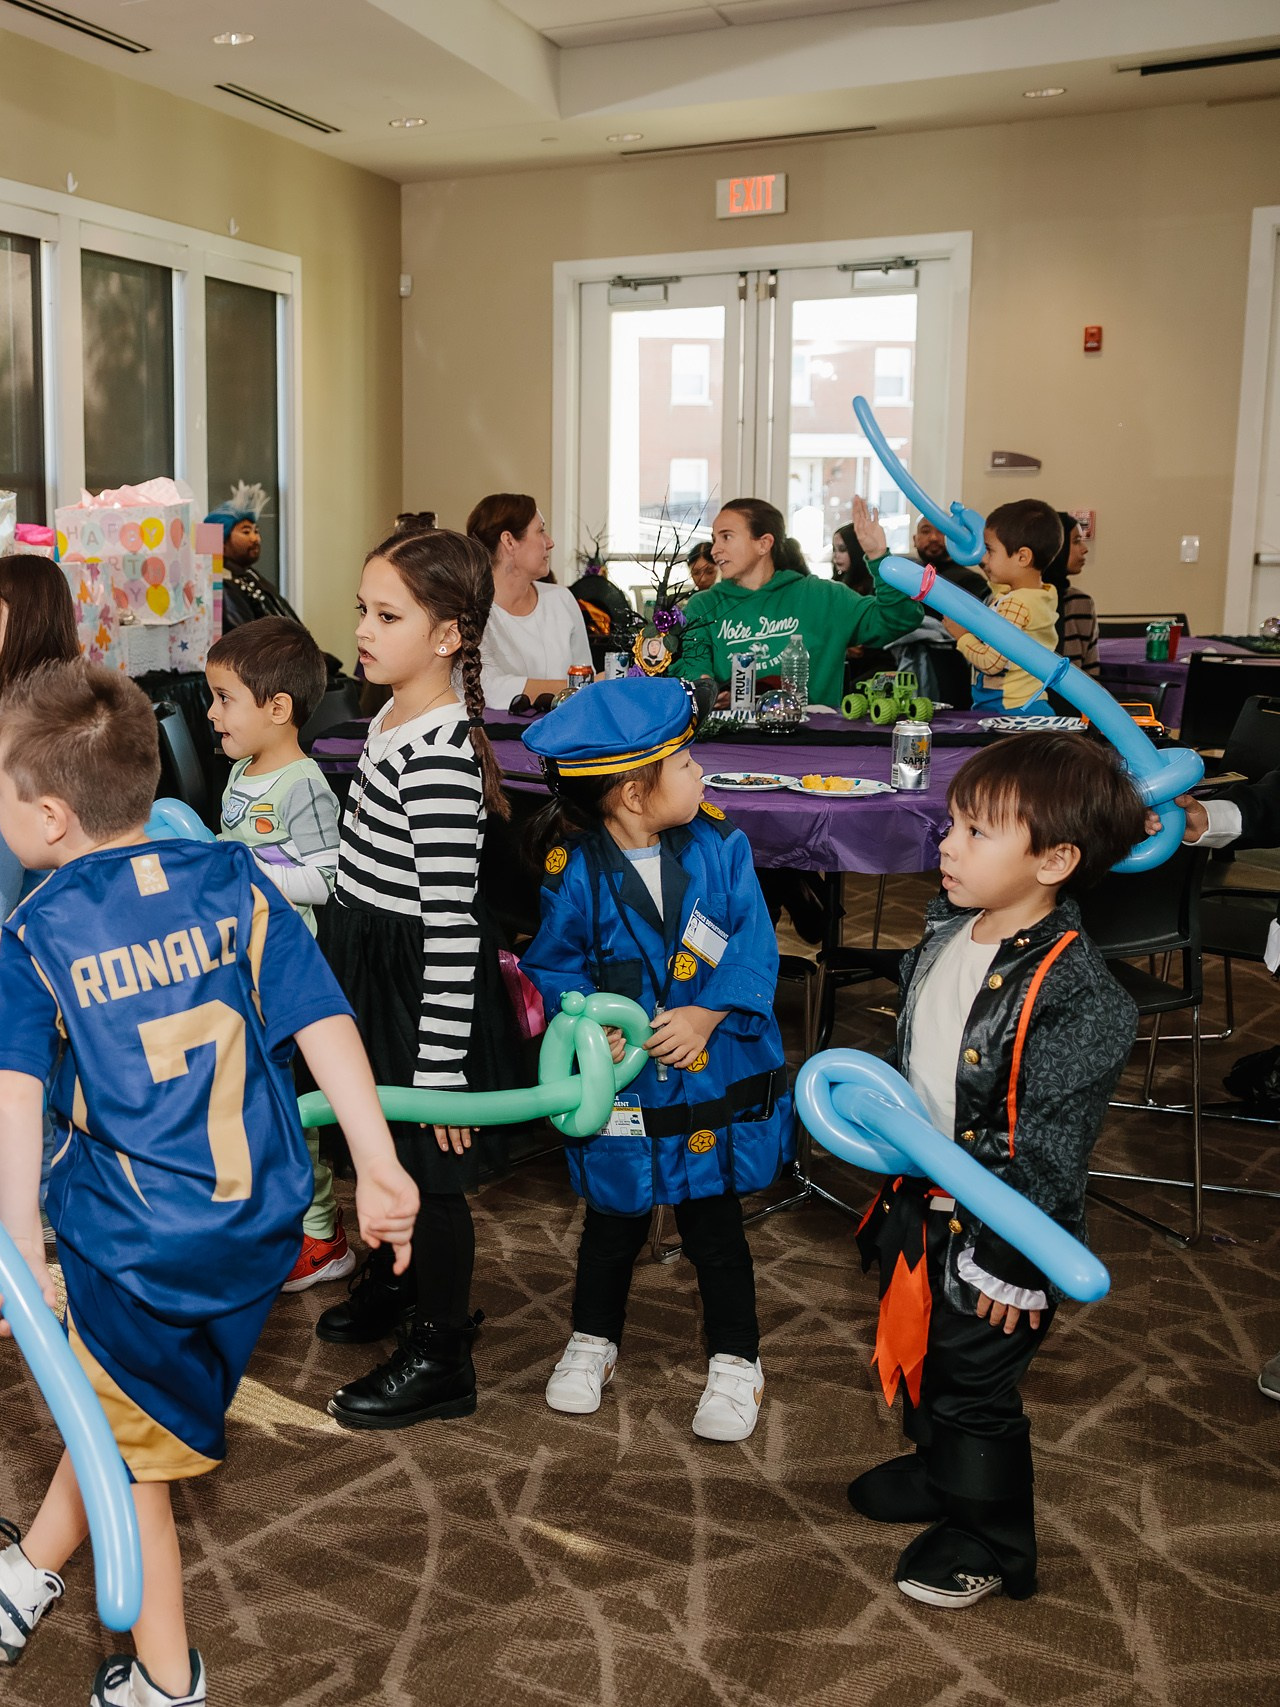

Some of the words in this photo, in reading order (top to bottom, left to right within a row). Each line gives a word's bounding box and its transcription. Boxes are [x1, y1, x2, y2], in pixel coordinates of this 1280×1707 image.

[729, 175, 776, 213] EXIT
[717, 619, 752, 640] Notre
[754, 616, 799, 637] Dame
[735, 669, 746, 703] TRULY
[902, 756, 931, 765] SAPPO
[70, 916, 238, 1009] RONALD
[137, 999, 252, 1202] 7
